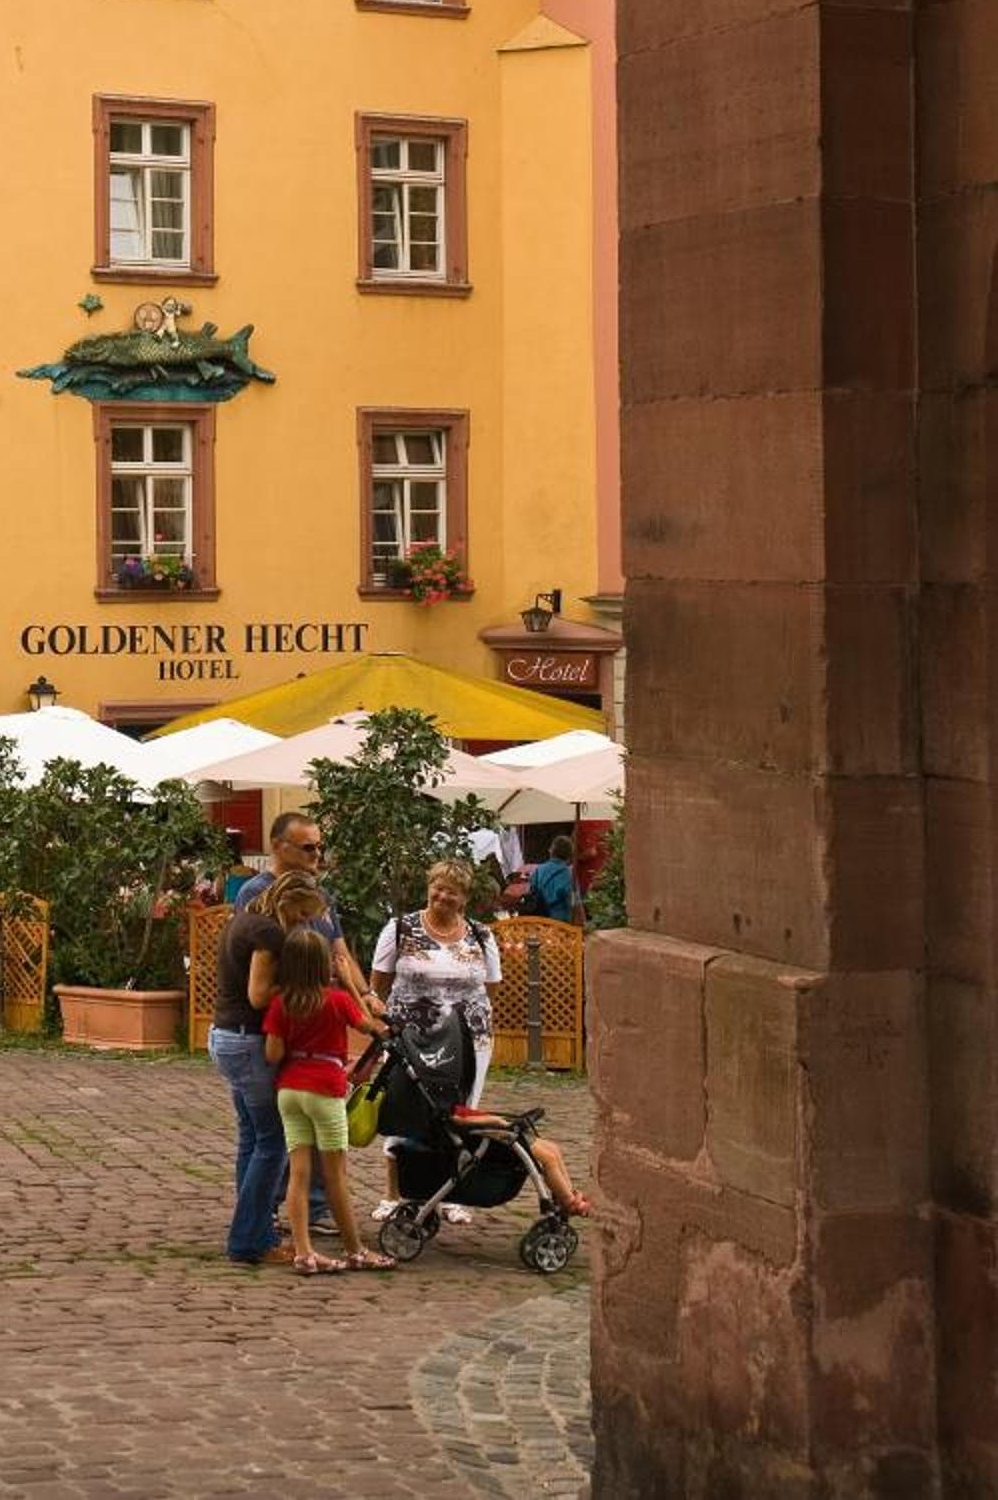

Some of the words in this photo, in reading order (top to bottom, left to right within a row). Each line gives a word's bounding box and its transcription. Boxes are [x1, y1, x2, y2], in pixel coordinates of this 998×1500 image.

[21, 624, 227, 655] GOLDENER
[244, 623, 369, 653] HECHT
[159, 659, 240, 681] HOTEL
[507, 656, 587, 682] Hotel
